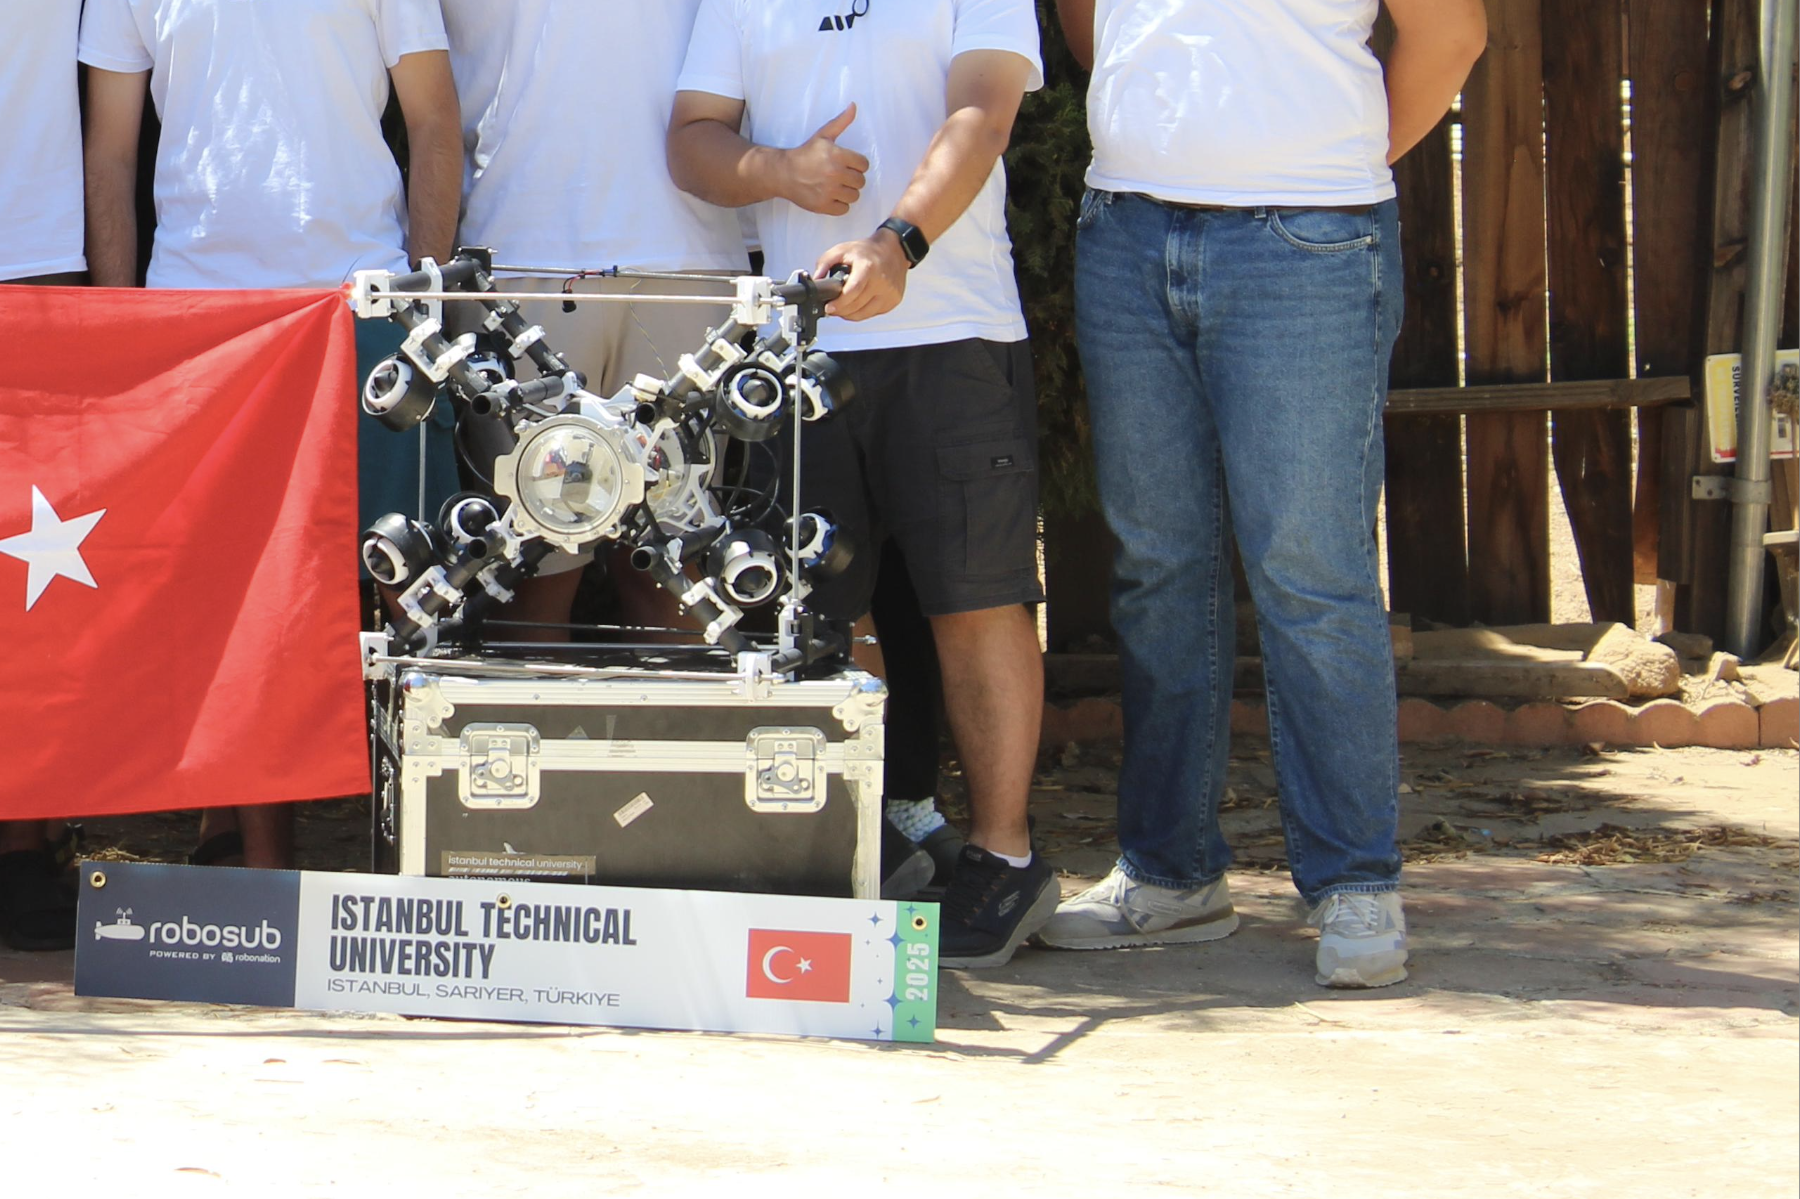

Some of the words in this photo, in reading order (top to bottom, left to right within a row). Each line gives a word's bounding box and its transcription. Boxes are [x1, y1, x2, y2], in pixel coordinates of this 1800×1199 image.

[489, 857, 535, 868] technical
[536, 859, 583, 872] university
[149, 915, 282, 950] robosub
[331, 893, 470, 938] ISTANBUL
[480, 900, 638, 946] TECHNICAL
[149, 949, 199, 959] POWERED
[202, 952, 216, 960] BY
[235, 954, 281, 964] robonation
[330, 935, 496, 980] UNIVERSITY
[905, 943, 930, 1001] 2025
[327, 978, 431, 999] ISTANBUL,
[435, 984, 529, 1005] SARIYER,
[533, 987, 621, 1007] TÜRKIYE
